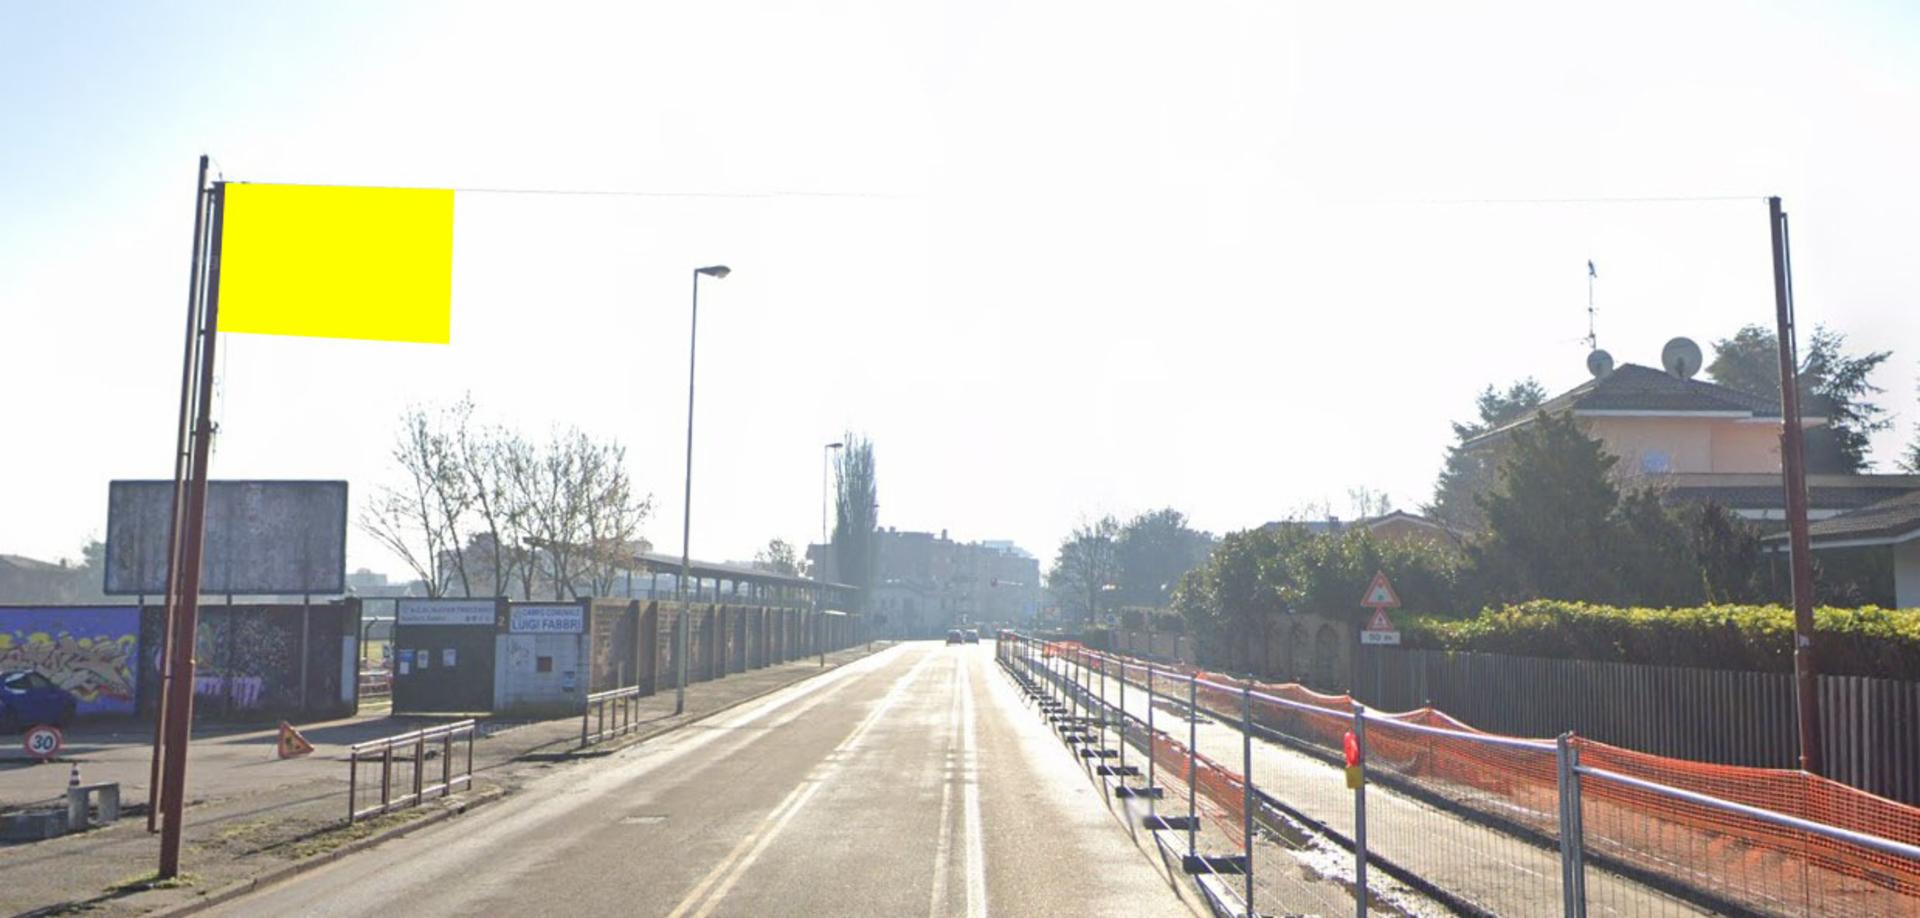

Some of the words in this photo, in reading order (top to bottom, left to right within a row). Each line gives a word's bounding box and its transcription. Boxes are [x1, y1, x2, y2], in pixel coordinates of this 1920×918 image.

[512, 618, 540, 630] LUIGI
[542, 618, 581, 630] FABBRI
[33, 734, 54, 750] 30
